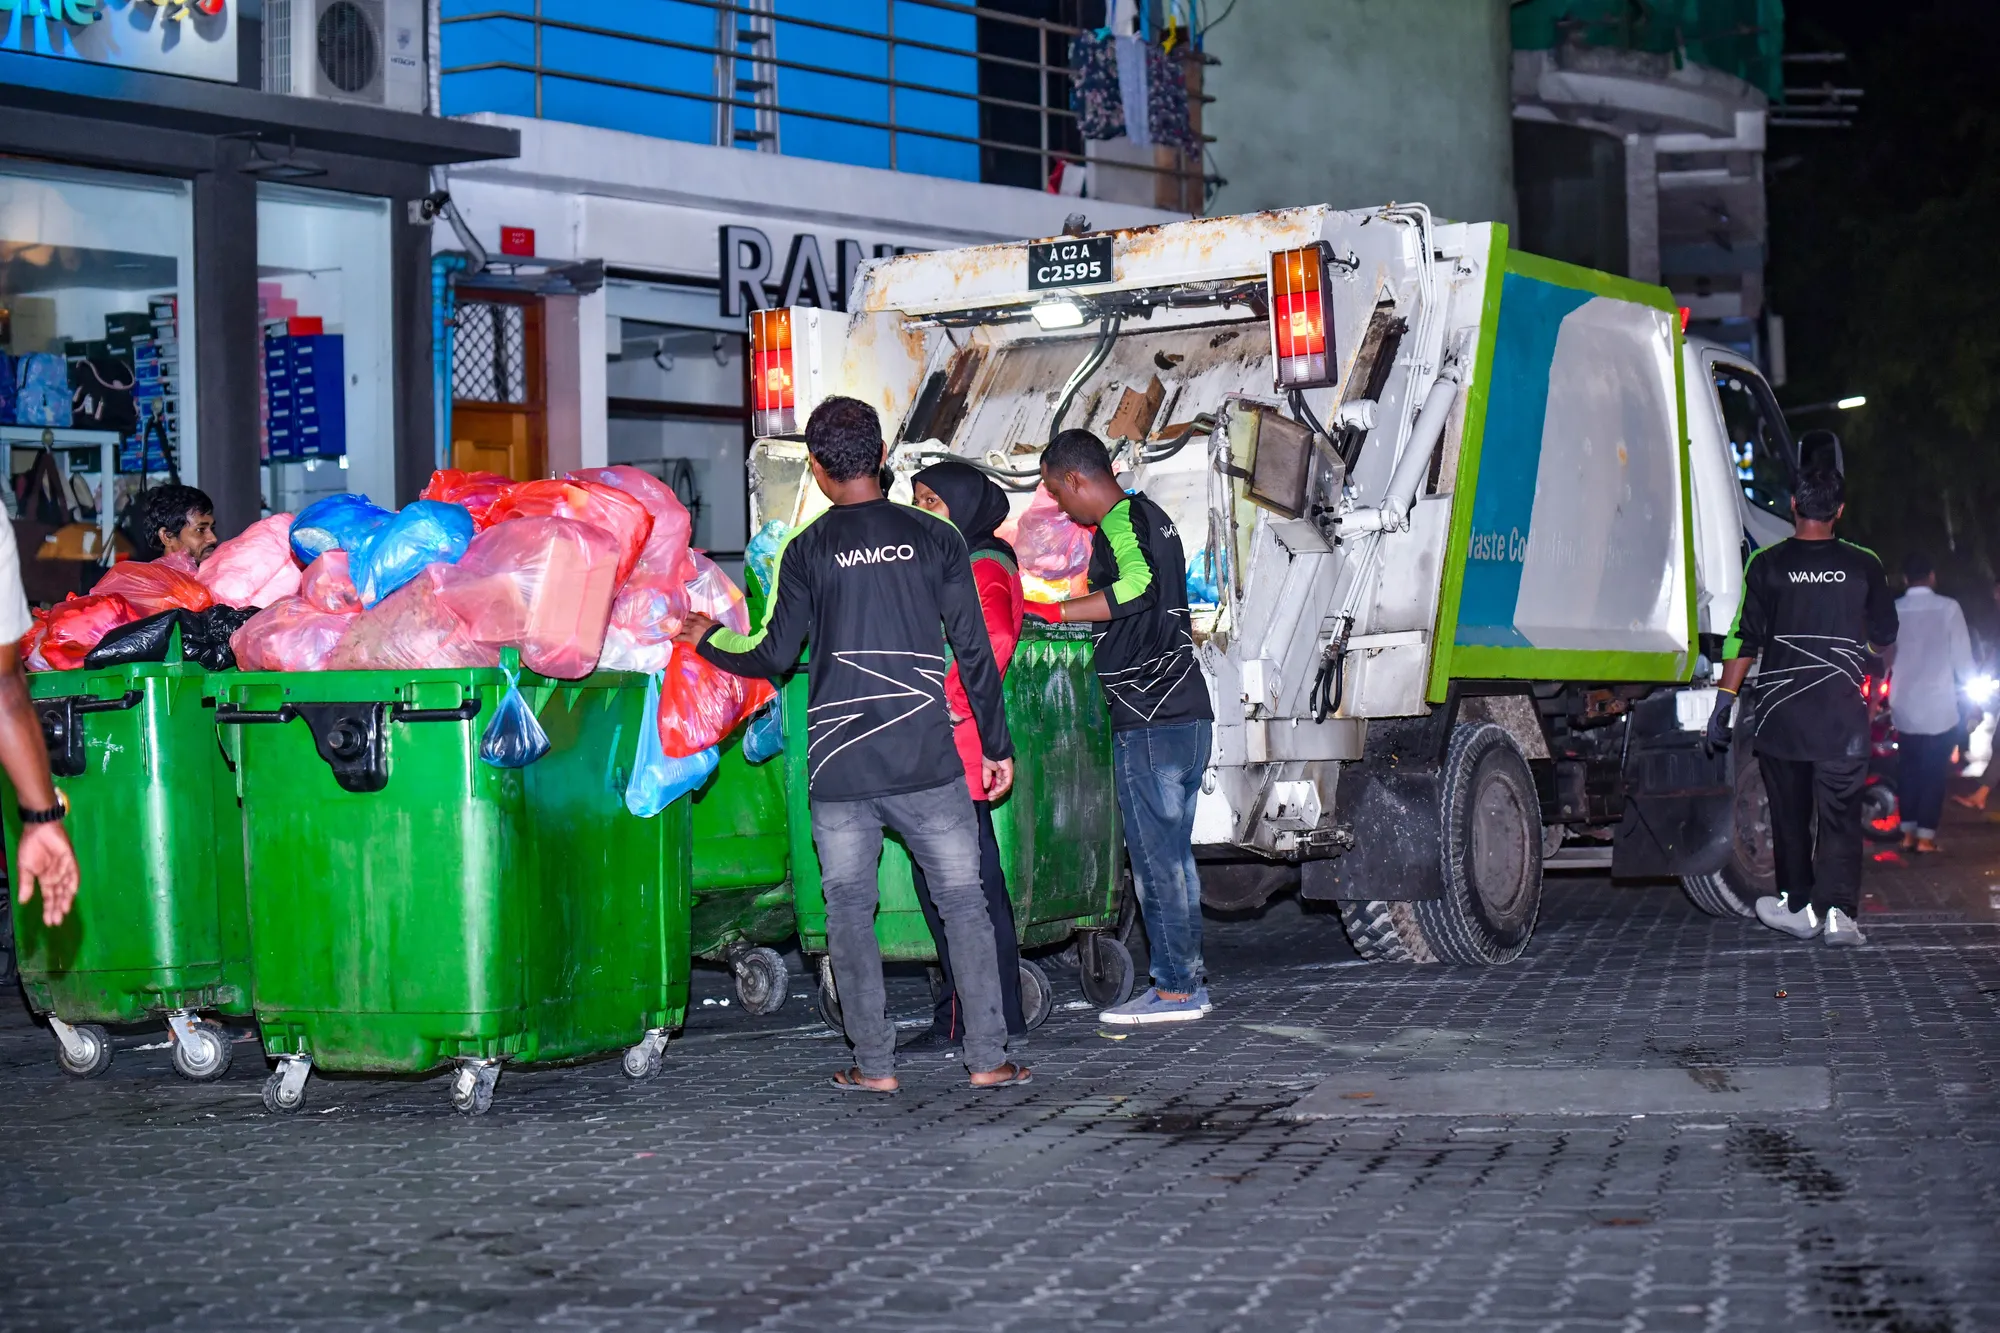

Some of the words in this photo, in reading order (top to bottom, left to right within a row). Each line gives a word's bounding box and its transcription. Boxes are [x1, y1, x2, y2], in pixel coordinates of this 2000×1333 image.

[1037, 261, 1102, 283] C2595
[834, 544, 914, 568] WAMCO
[1788, 570, 1846, 583] WAMCO
